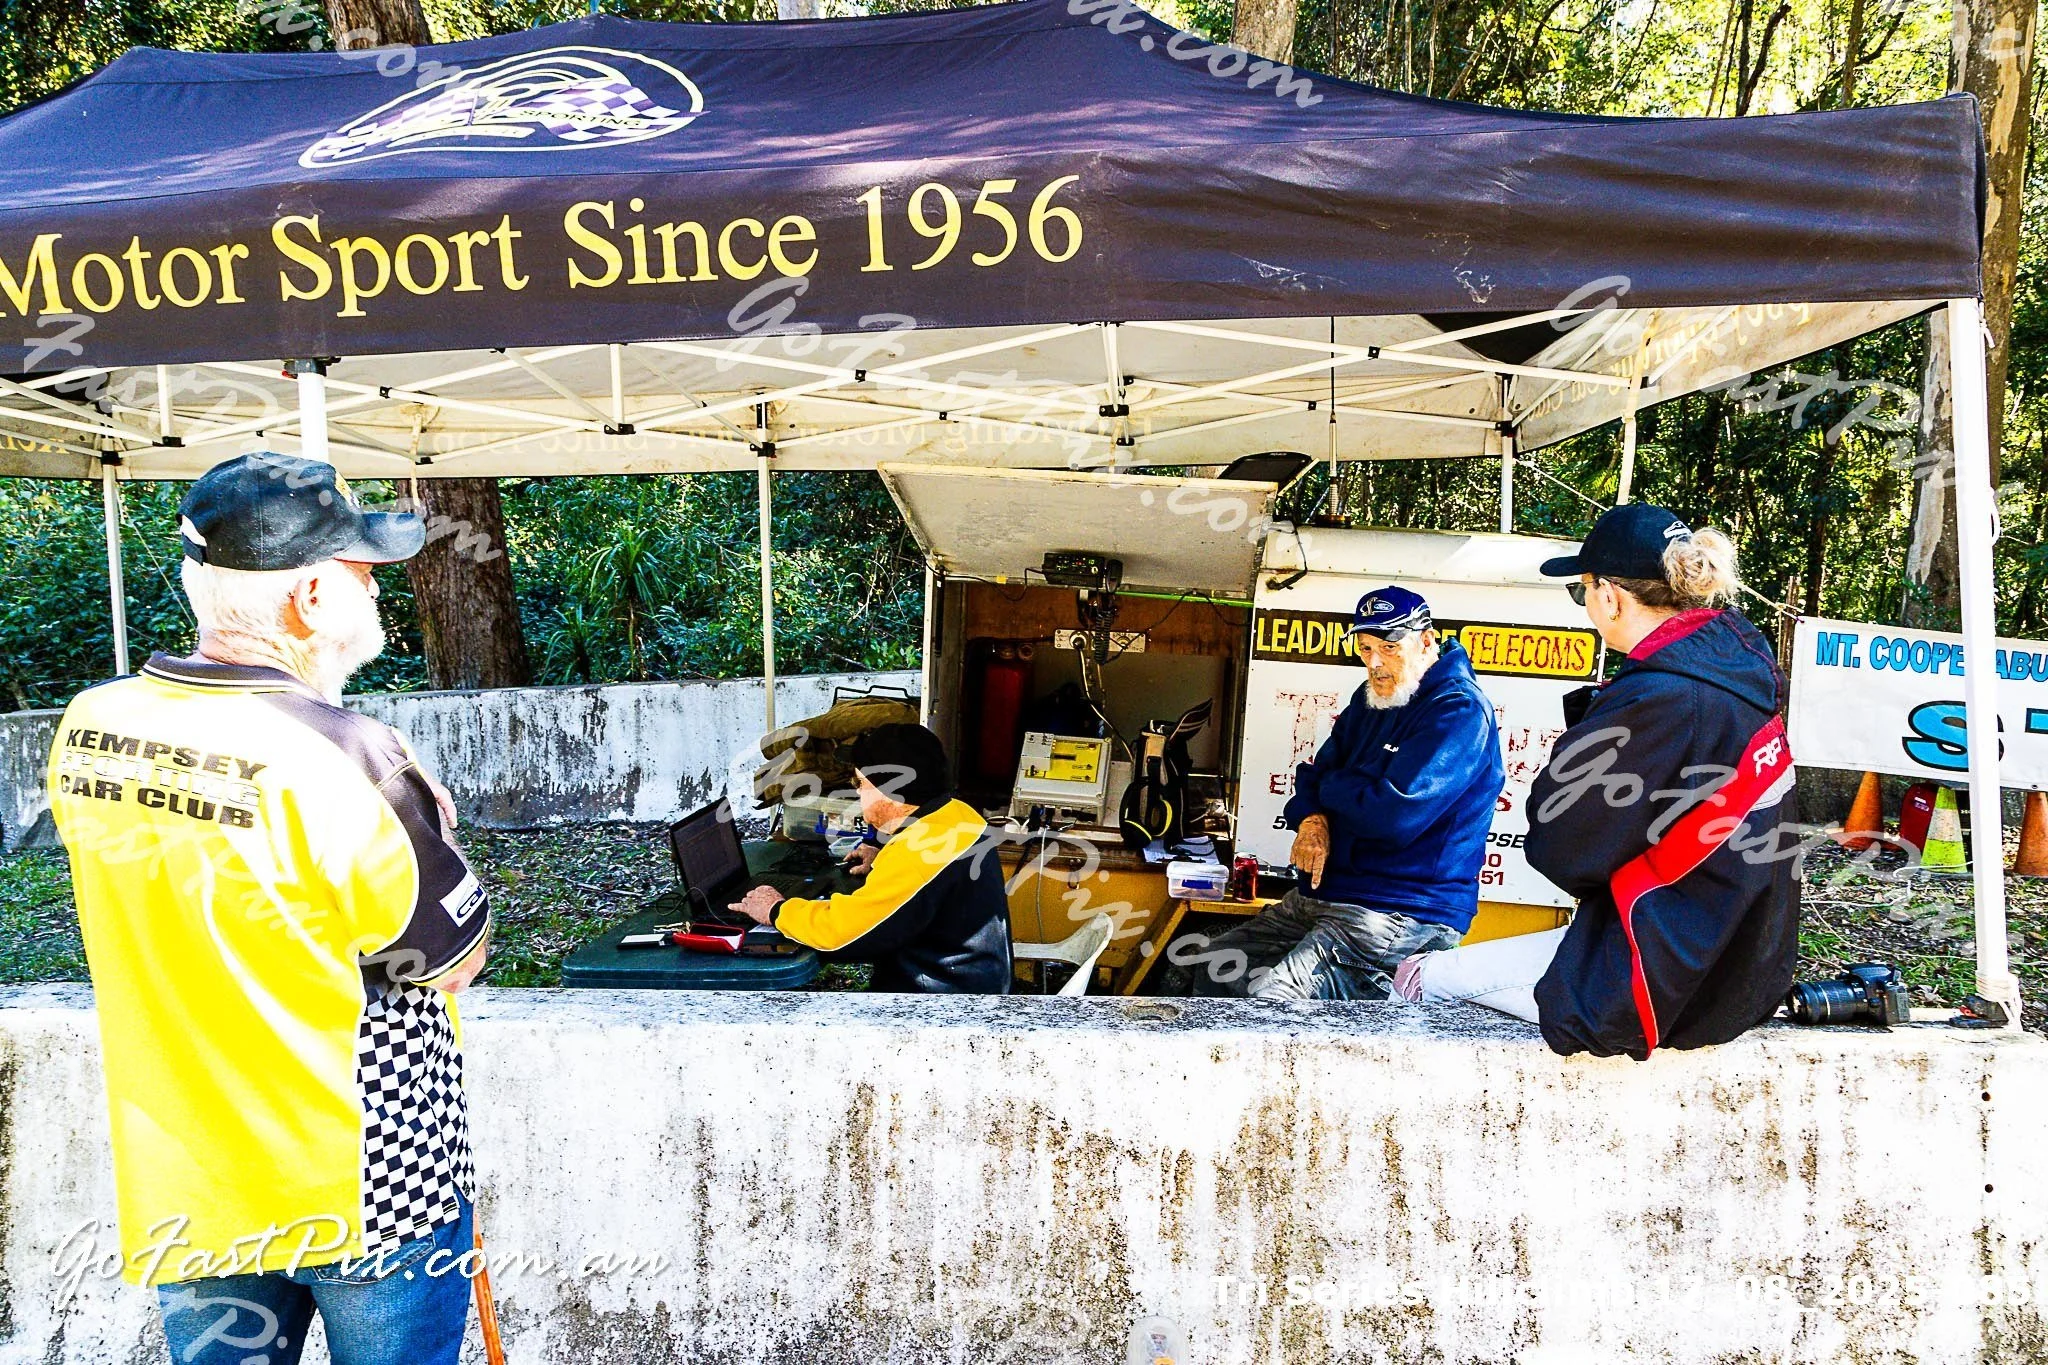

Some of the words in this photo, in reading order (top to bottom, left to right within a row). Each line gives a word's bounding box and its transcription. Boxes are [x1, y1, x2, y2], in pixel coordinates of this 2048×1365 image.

[0, 233, 249, 318] Motor
[278, 212, 530, 318] Sport
[563, 197, 819, 288] Since
[855, 174, 1084, 272] 1956
[1256, 617, 1363, 656] LEADIN
[1468, 631, 1587, 671] TELECOMS
[1815, 632, 1860, 668] MT.
[1869, 636, 2048, 682] COOPEABU
[60, 751, 261, 806] SPORTING
[65, 728, 268, 781] KEMPSEY
[60, 774, 123, 801] CAR
[137, 788, 254, 828] CLUB
